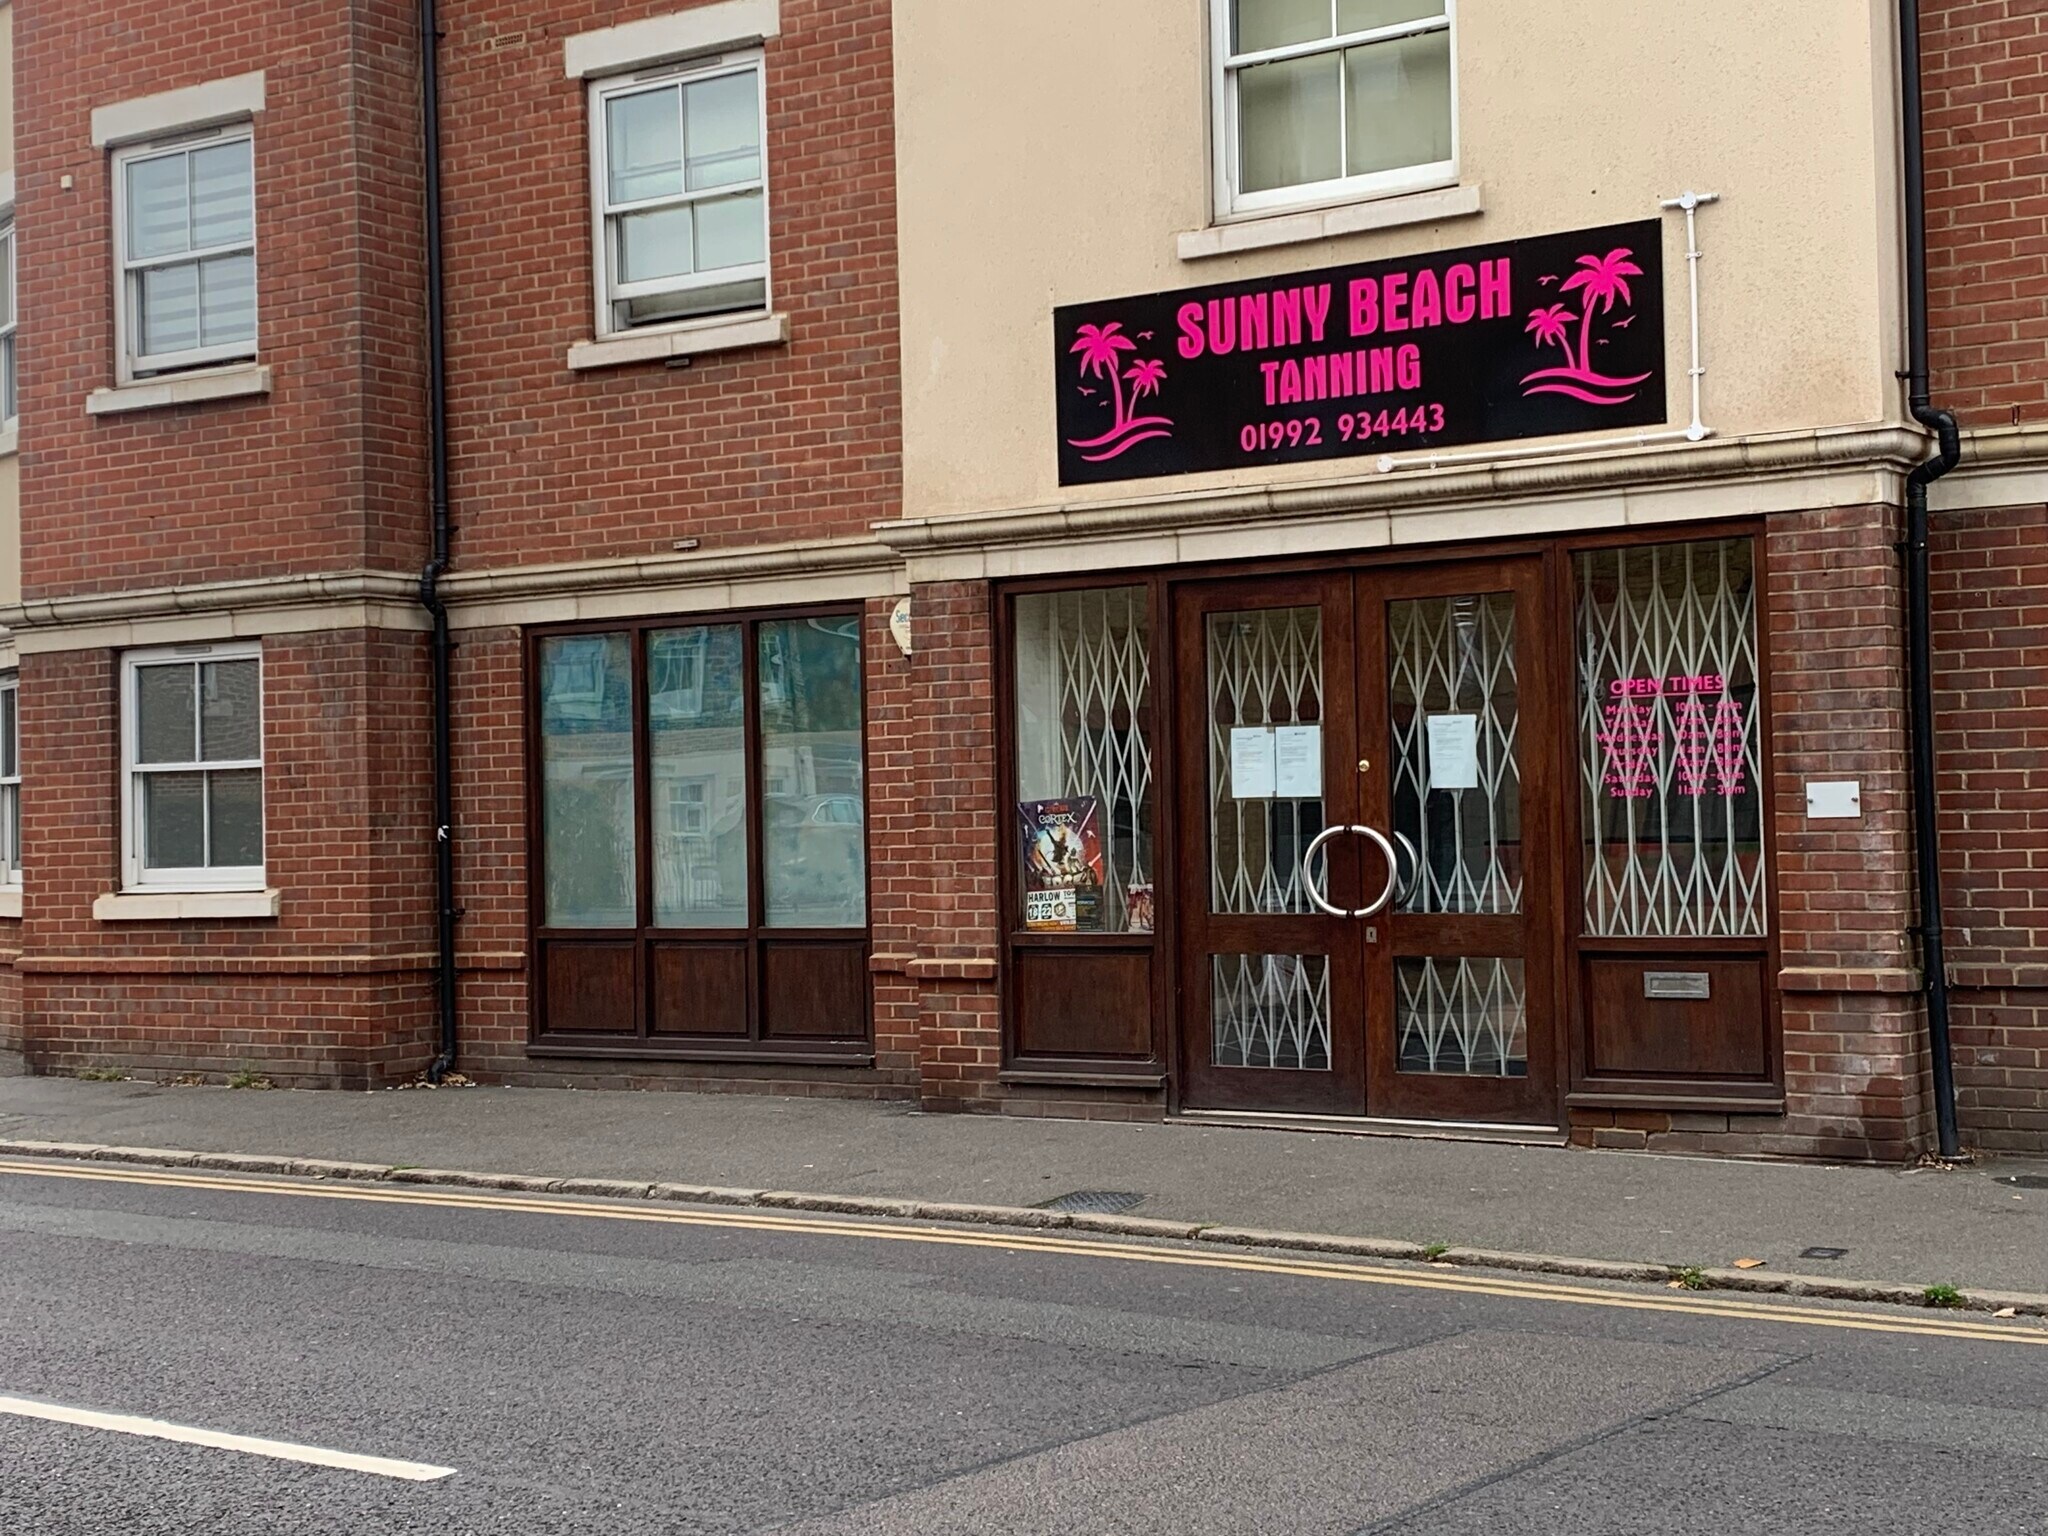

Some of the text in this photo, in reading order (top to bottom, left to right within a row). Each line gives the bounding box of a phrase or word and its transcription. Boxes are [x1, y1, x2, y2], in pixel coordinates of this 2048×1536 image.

[1177, 258, 1510, 359] SUNNY BEACH
[1260, 344, 1422, 406] TANNING
[1240, 403, 1445, 452] 01992 934443
[1610, 675, 1725, 695] OPEN TIMES
[1605, 772, 1659, 784] Saturday
[1610, 786, 1653, 798] Sunday
[1028, 891, 1061, 904] HARLOW
[1041, 907, 1052, 916] 22
